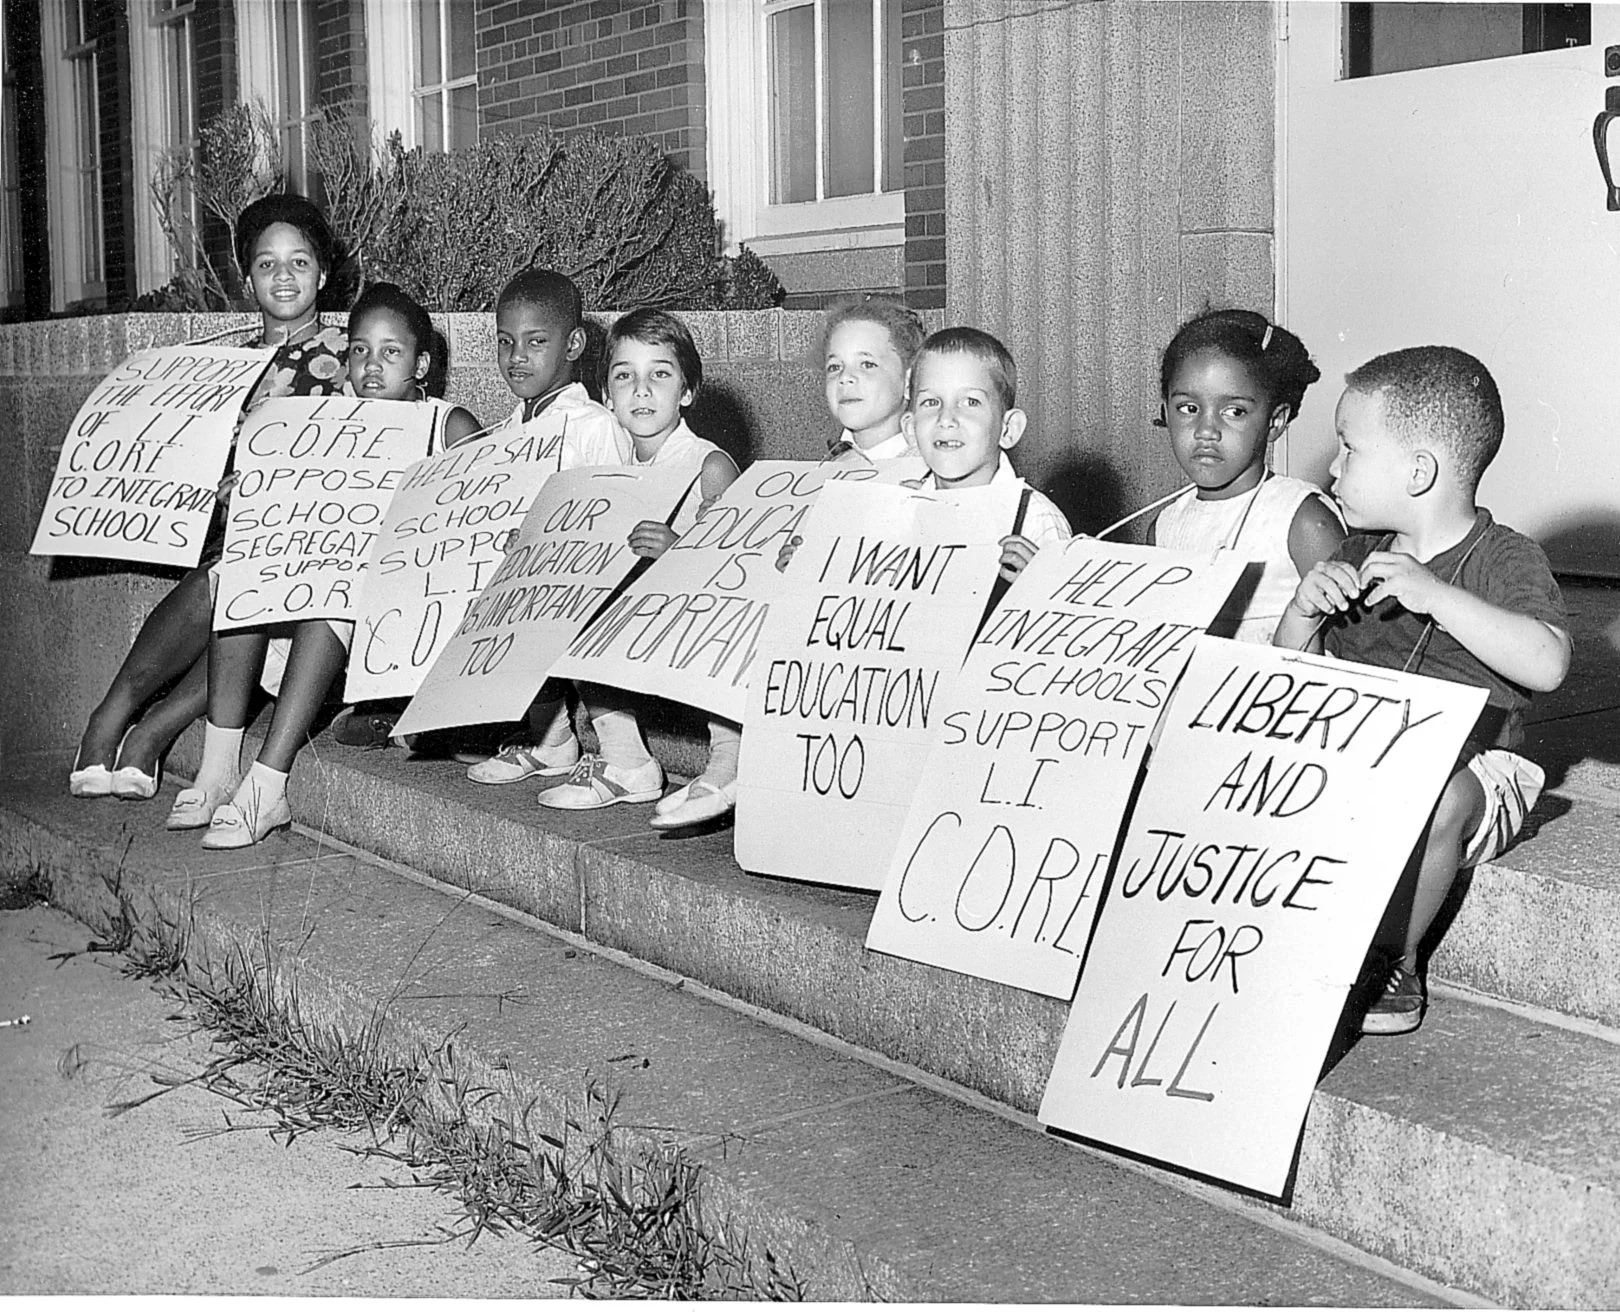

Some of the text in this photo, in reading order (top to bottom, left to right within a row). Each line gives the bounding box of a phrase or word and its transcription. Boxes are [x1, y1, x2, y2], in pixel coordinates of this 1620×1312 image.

[115, 356, 267, 384] SUPPORT
[93, 383, 250, 412] THE EFFORT
[77, 410, 120, 438] OF
[248, 421, 404, 459] C.O.R.E.
[239, 468, 405, 498] OPPOSE
[402, 435, 562, 491] HELP SAVE
[52, 476, 219, 514] TO INTEGRATE
[435, 473, 511, 506] OUR
[48, 506, 189, 549] SCHOOLS
[232, 500, 384, 532] SCHOO
[394, 496, 529, 540] SCHOOL
[543, 497, 611, 534] OUR
[225, 529, 379, 564] SEGREGAT
[491, 539, 626, 588] EDUCATION
[818, 536, 967, 595] I WANT
[702, 552, 762, 591] IS
[1049, 558, 1193, 608] HELP
[475, 583, 613, 632] IMPORTANT
[806, 595, 911, 652] EQUAL
[458, 632, 515, 677] TOO
[568, 593, 770, 689] IMPORTAN
[976, 608, 1207, 674] INTEGRATE
[764, 660, 940, 729] EDUCATION
[985, 661, 1167, 708] SCHOOLS
[943, 709, 1146, 760] SUPPORT
[1188, 664, 1444, 769] LIBERTY
[796, 732, 865, 800] TOO
[980, 758, 1060, 810] L.I.
[1203, 750, 1328, 818] AND
[1122, 828, 1348, 911] JUSTICE
[1161, 919, 1263, 994] FOR
[1090, 992, 1220, 1103] ALL
